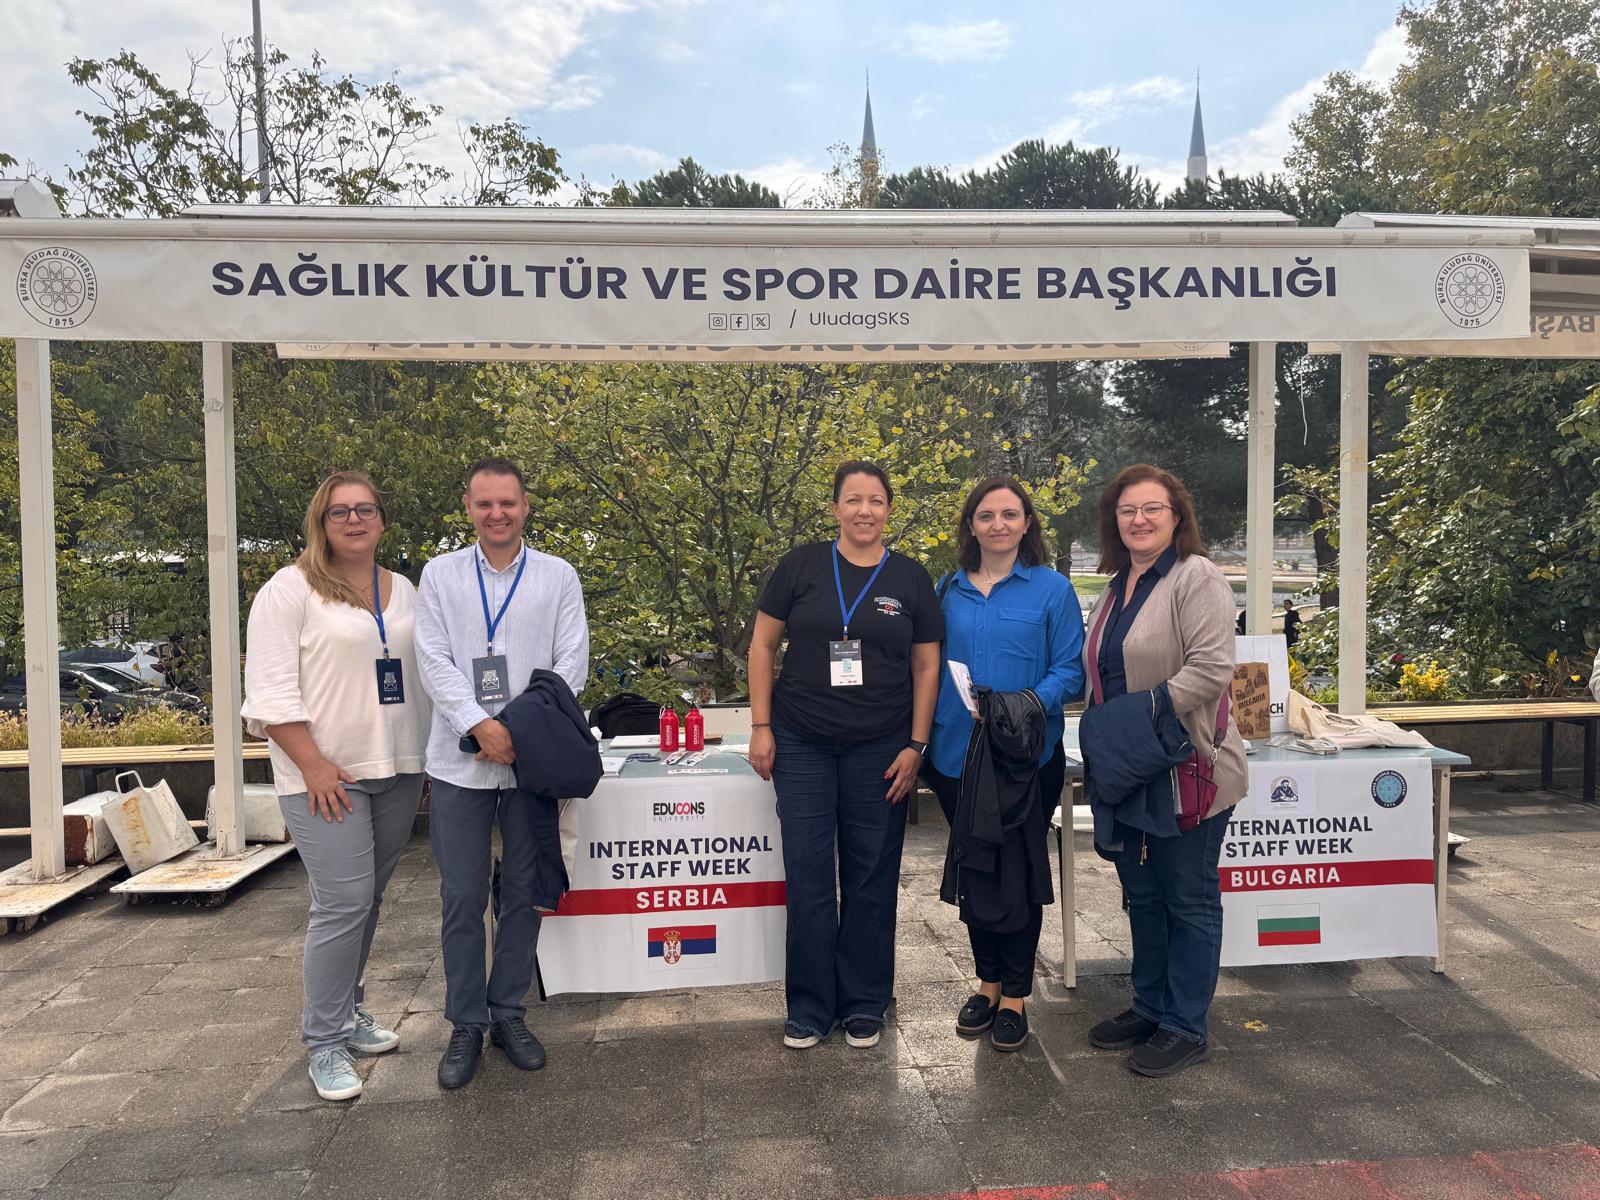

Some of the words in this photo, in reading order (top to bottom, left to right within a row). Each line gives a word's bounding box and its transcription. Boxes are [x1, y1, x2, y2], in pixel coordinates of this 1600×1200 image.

[20, 271, 30, 302] BURSA
[25, 249, 59, 270] ULUDAĞ
[212, 252, 410, 297] SAĞLIK
[425, 254, 627, 299] KÜLTÜR
[642, 267, 707, 301] VE
[723, 267, 858, 301] SPOR
[874, 258, 1021, 300] DAİRE
[1037, 256, 1337, 311] BAŞKANLIĞI
[1437, 276, 1446, 304] BURSA
[1442, 254, 1473, 275] ULUDAĞ
[48, 317, 75, 327] 1975
[809, 311, 910, 329] UludagSKS
[1459, 318, 1480, 327] 1975
[653, 801, 705, 816] EDUCONS
[1229, 815, 1373, 837] TERNATIONAL
[589, 835, 773, 859] INTERNATIONAL
[1225, 839, 1289, 858] STAFF
[1295, 837, 1353, 855] WEEK
[611, 860, 683, 880] STAFF
[688, 857, 751, 877] WEEK
[1231, 866, 1341, 888] BULGARIA
[636, 887, 728, 910] SERBIA
